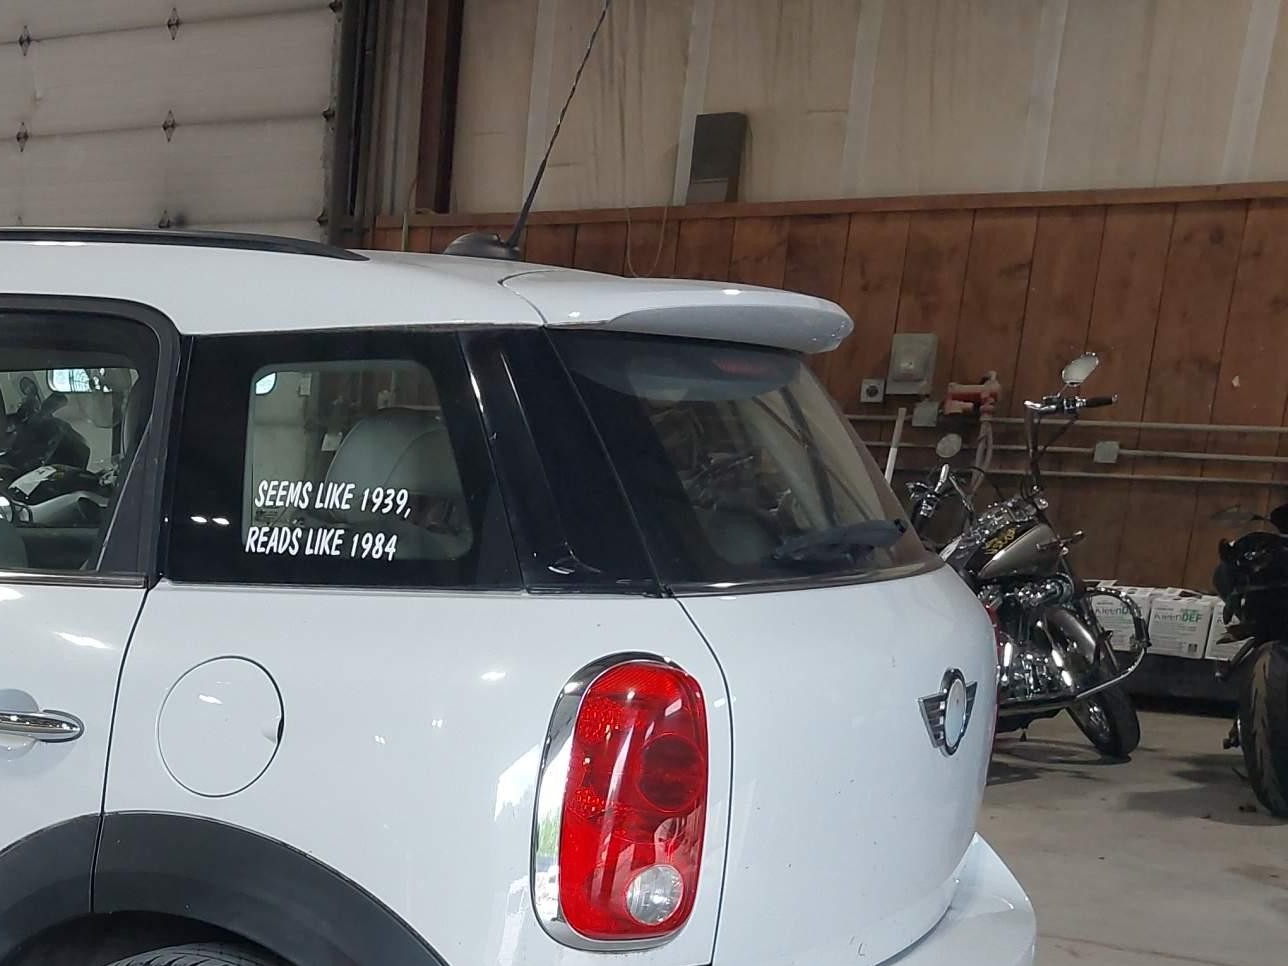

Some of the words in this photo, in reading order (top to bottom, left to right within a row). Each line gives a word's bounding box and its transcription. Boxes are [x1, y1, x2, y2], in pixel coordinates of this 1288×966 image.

[254, 480, 313, 510] SEEMS
[314, 482, 355, 510] LIKE
[360, 486, 412, 519] 1939,
[245, 526, 302, 556] READS
[305, 528, 345, 556] LIKE
[350, 532, 399, 562] 1984
